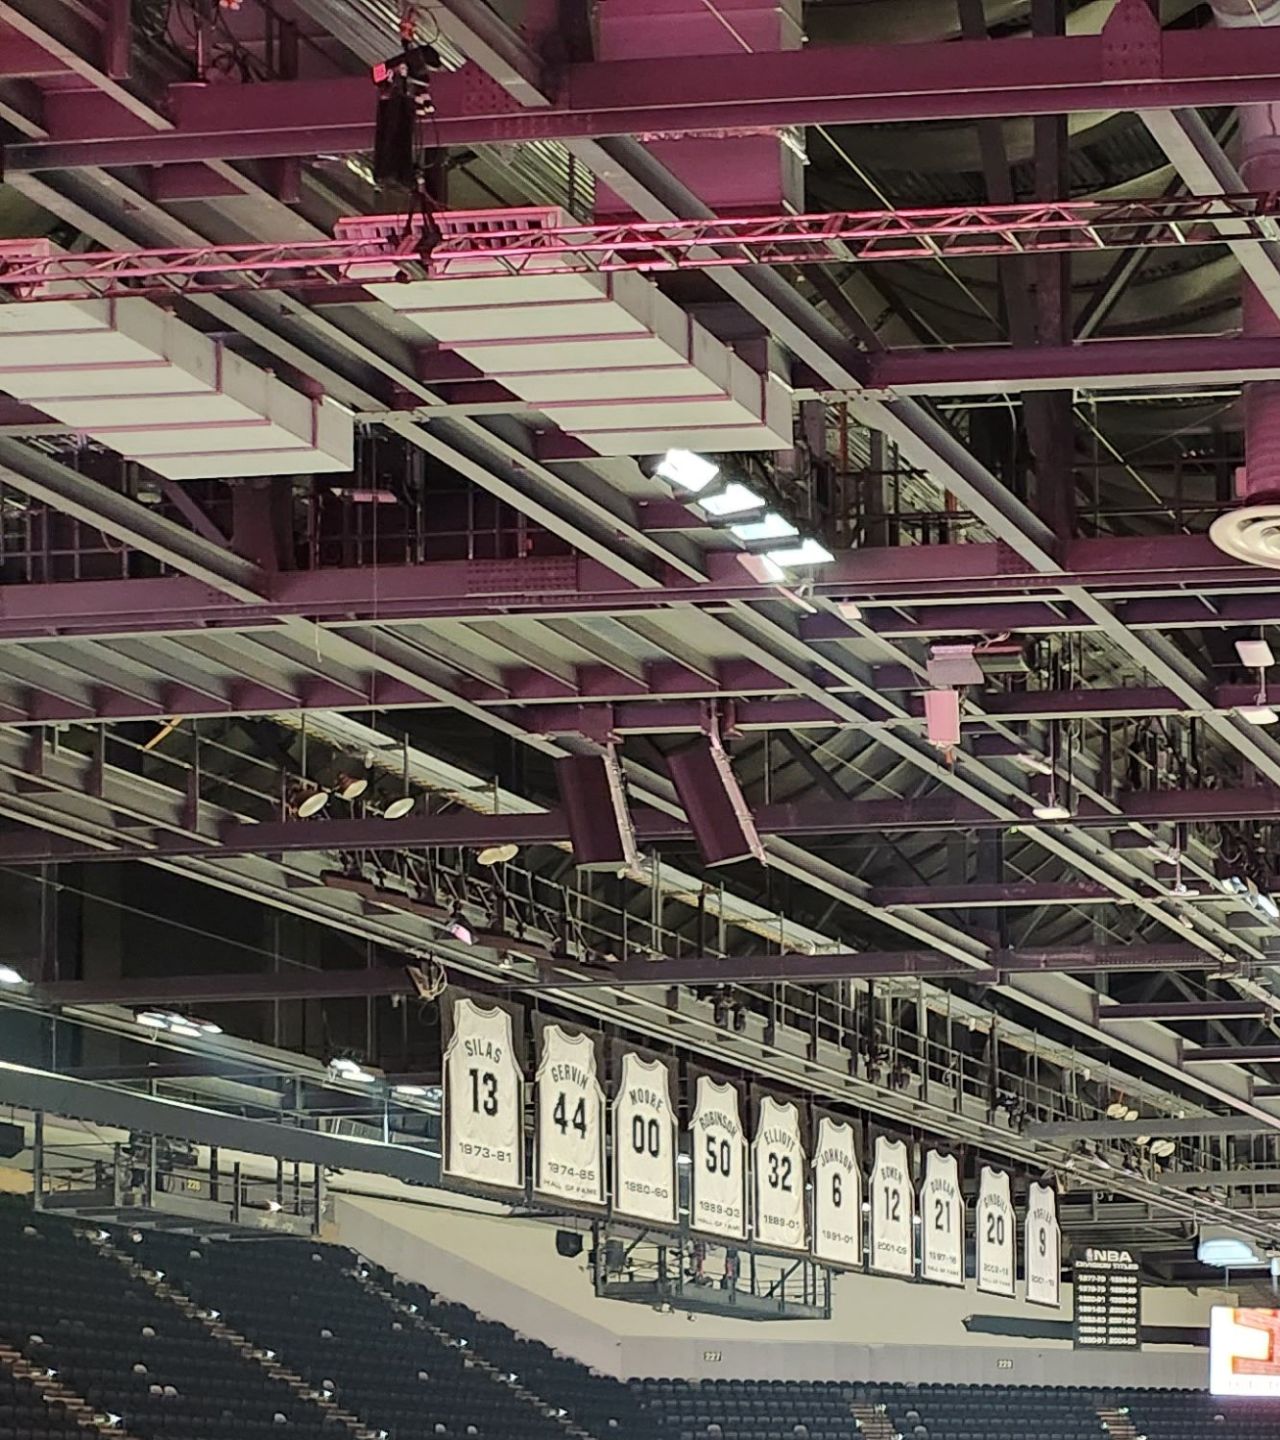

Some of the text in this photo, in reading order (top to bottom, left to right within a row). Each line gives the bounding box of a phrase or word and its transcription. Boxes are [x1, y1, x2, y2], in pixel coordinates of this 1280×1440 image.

[464, 1039, 502, 1064] SILAS
[469, 1068, 498, 1117] 13
[551, 1063, 589, 1090] GERVIN
[553, 1091, 587, 1139] 44
[629, 1088, 664, 1113] MOORE
[632, 1114, 660, 1159] 00
[700, 1110, 737, 1138] ROBINSON
[764, 1127, 796, 1152] ELLIOTT
[459, 1141, 512, 1163] 1973-81
[706, 1135, 731, 1178] 50
[820, 1148, 853, 1174] JOHNSON
[768, 1152, 792, 1193] 32
[832, 1172, 842, 1208] 6
[884, 1186, 900, 1223] 12
[935, 1198, 951, 1233] 21
[986, 1211, 1005, 1247] 20
[1038, 1226, 1047, 1257] 9
[1094, 1249, 1132, 1262] NBA
